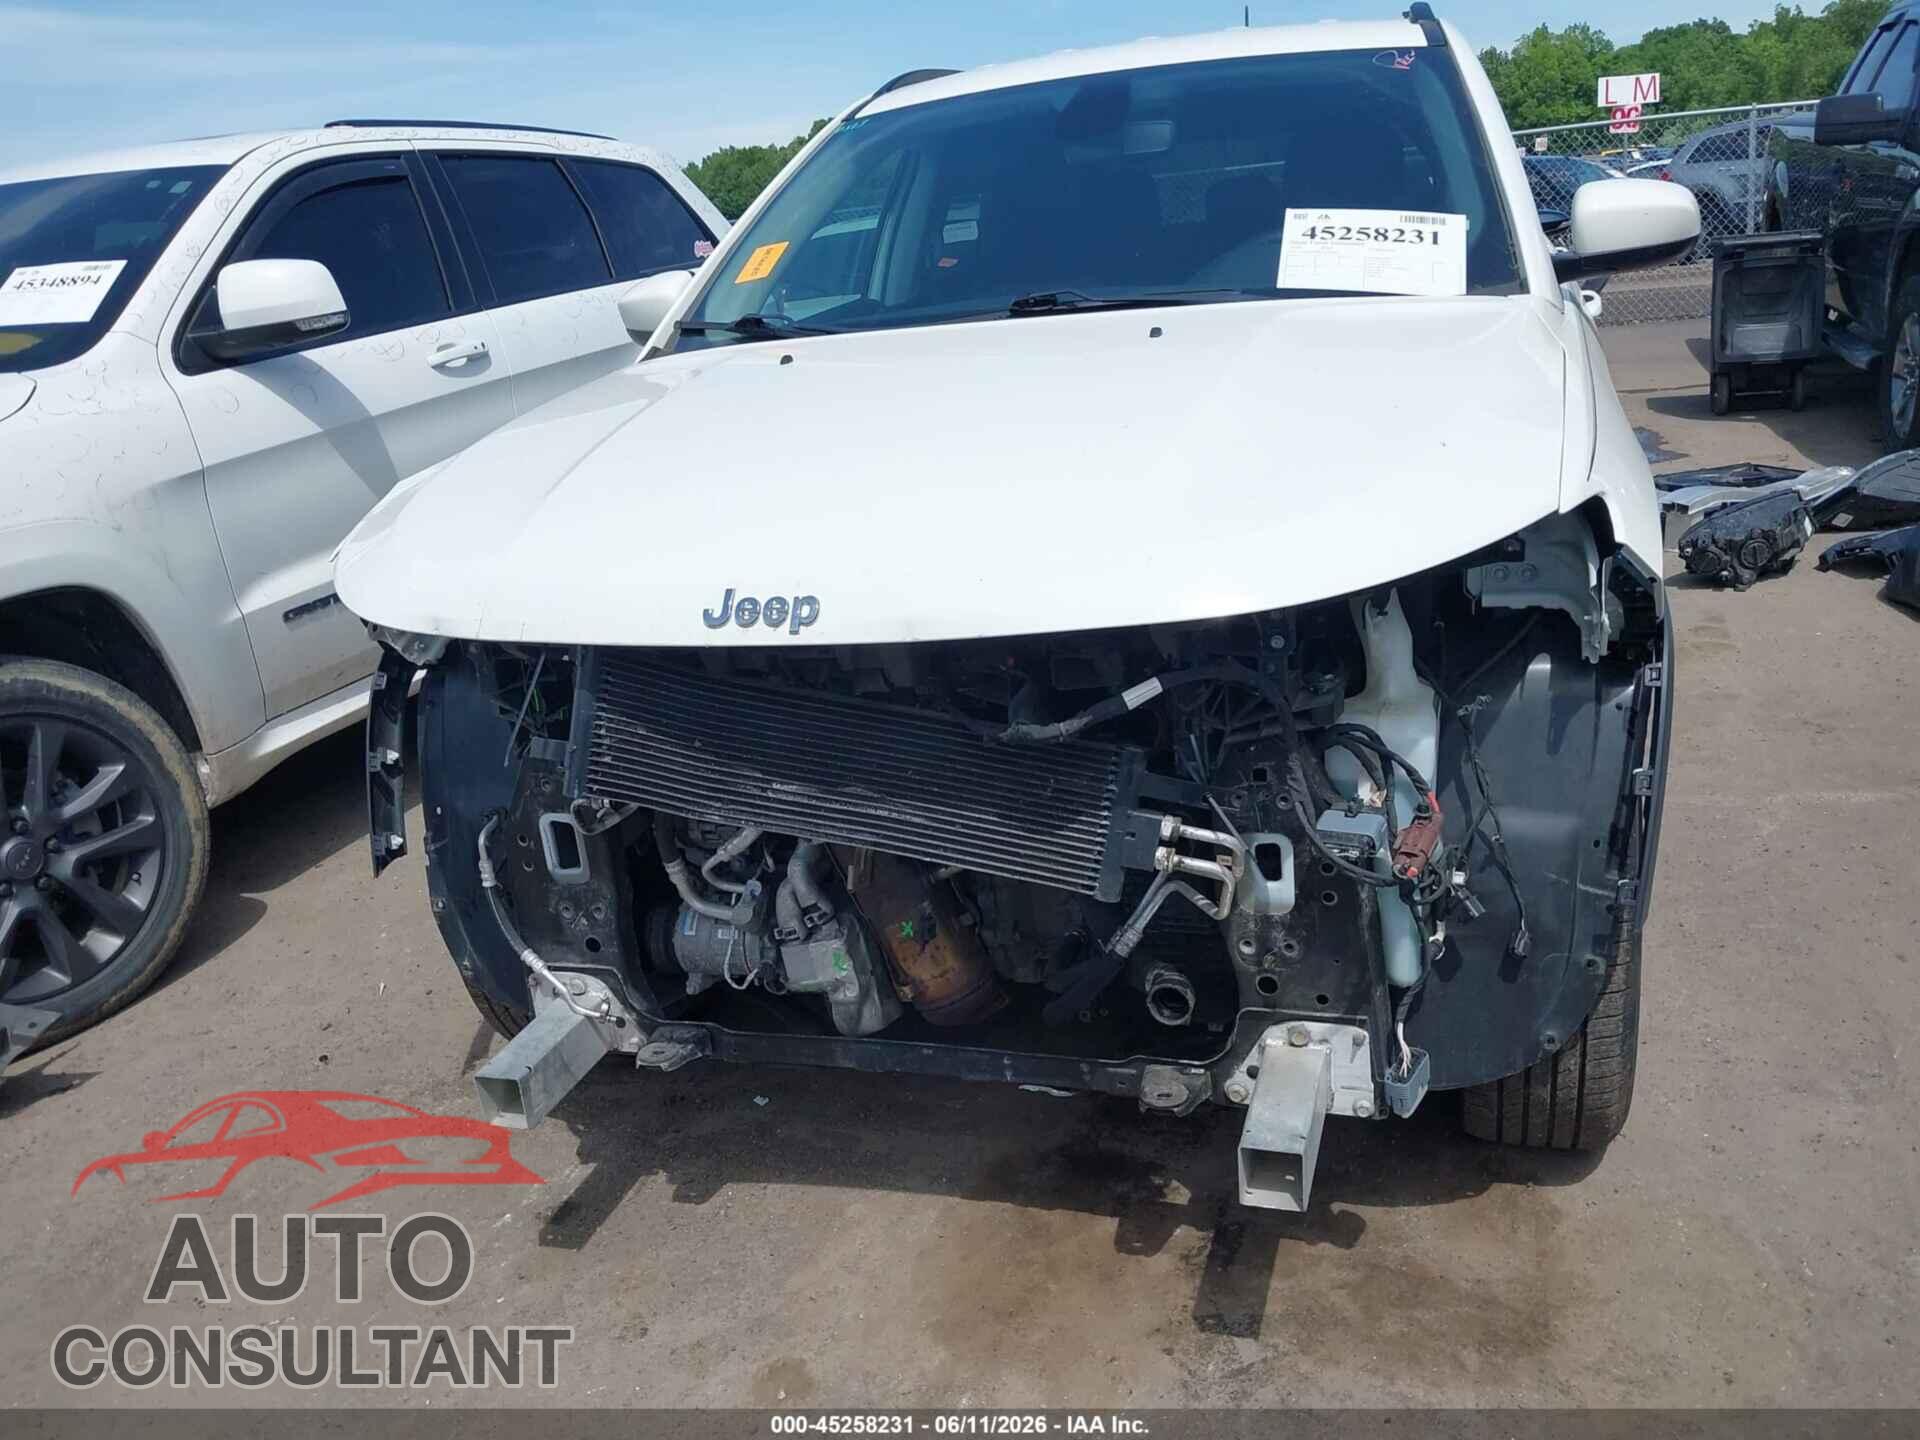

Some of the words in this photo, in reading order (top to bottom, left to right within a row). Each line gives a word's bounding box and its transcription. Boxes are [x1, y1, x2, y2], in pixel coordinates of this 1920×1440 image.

[1605, 78, 1618, 105] L
[1633, 75, 1658, 102] M
[1301, 225, 1440, 246] 45258231
[12, 273, 103, 291] 45348894
[702, 588, 821, 636] Jeep
